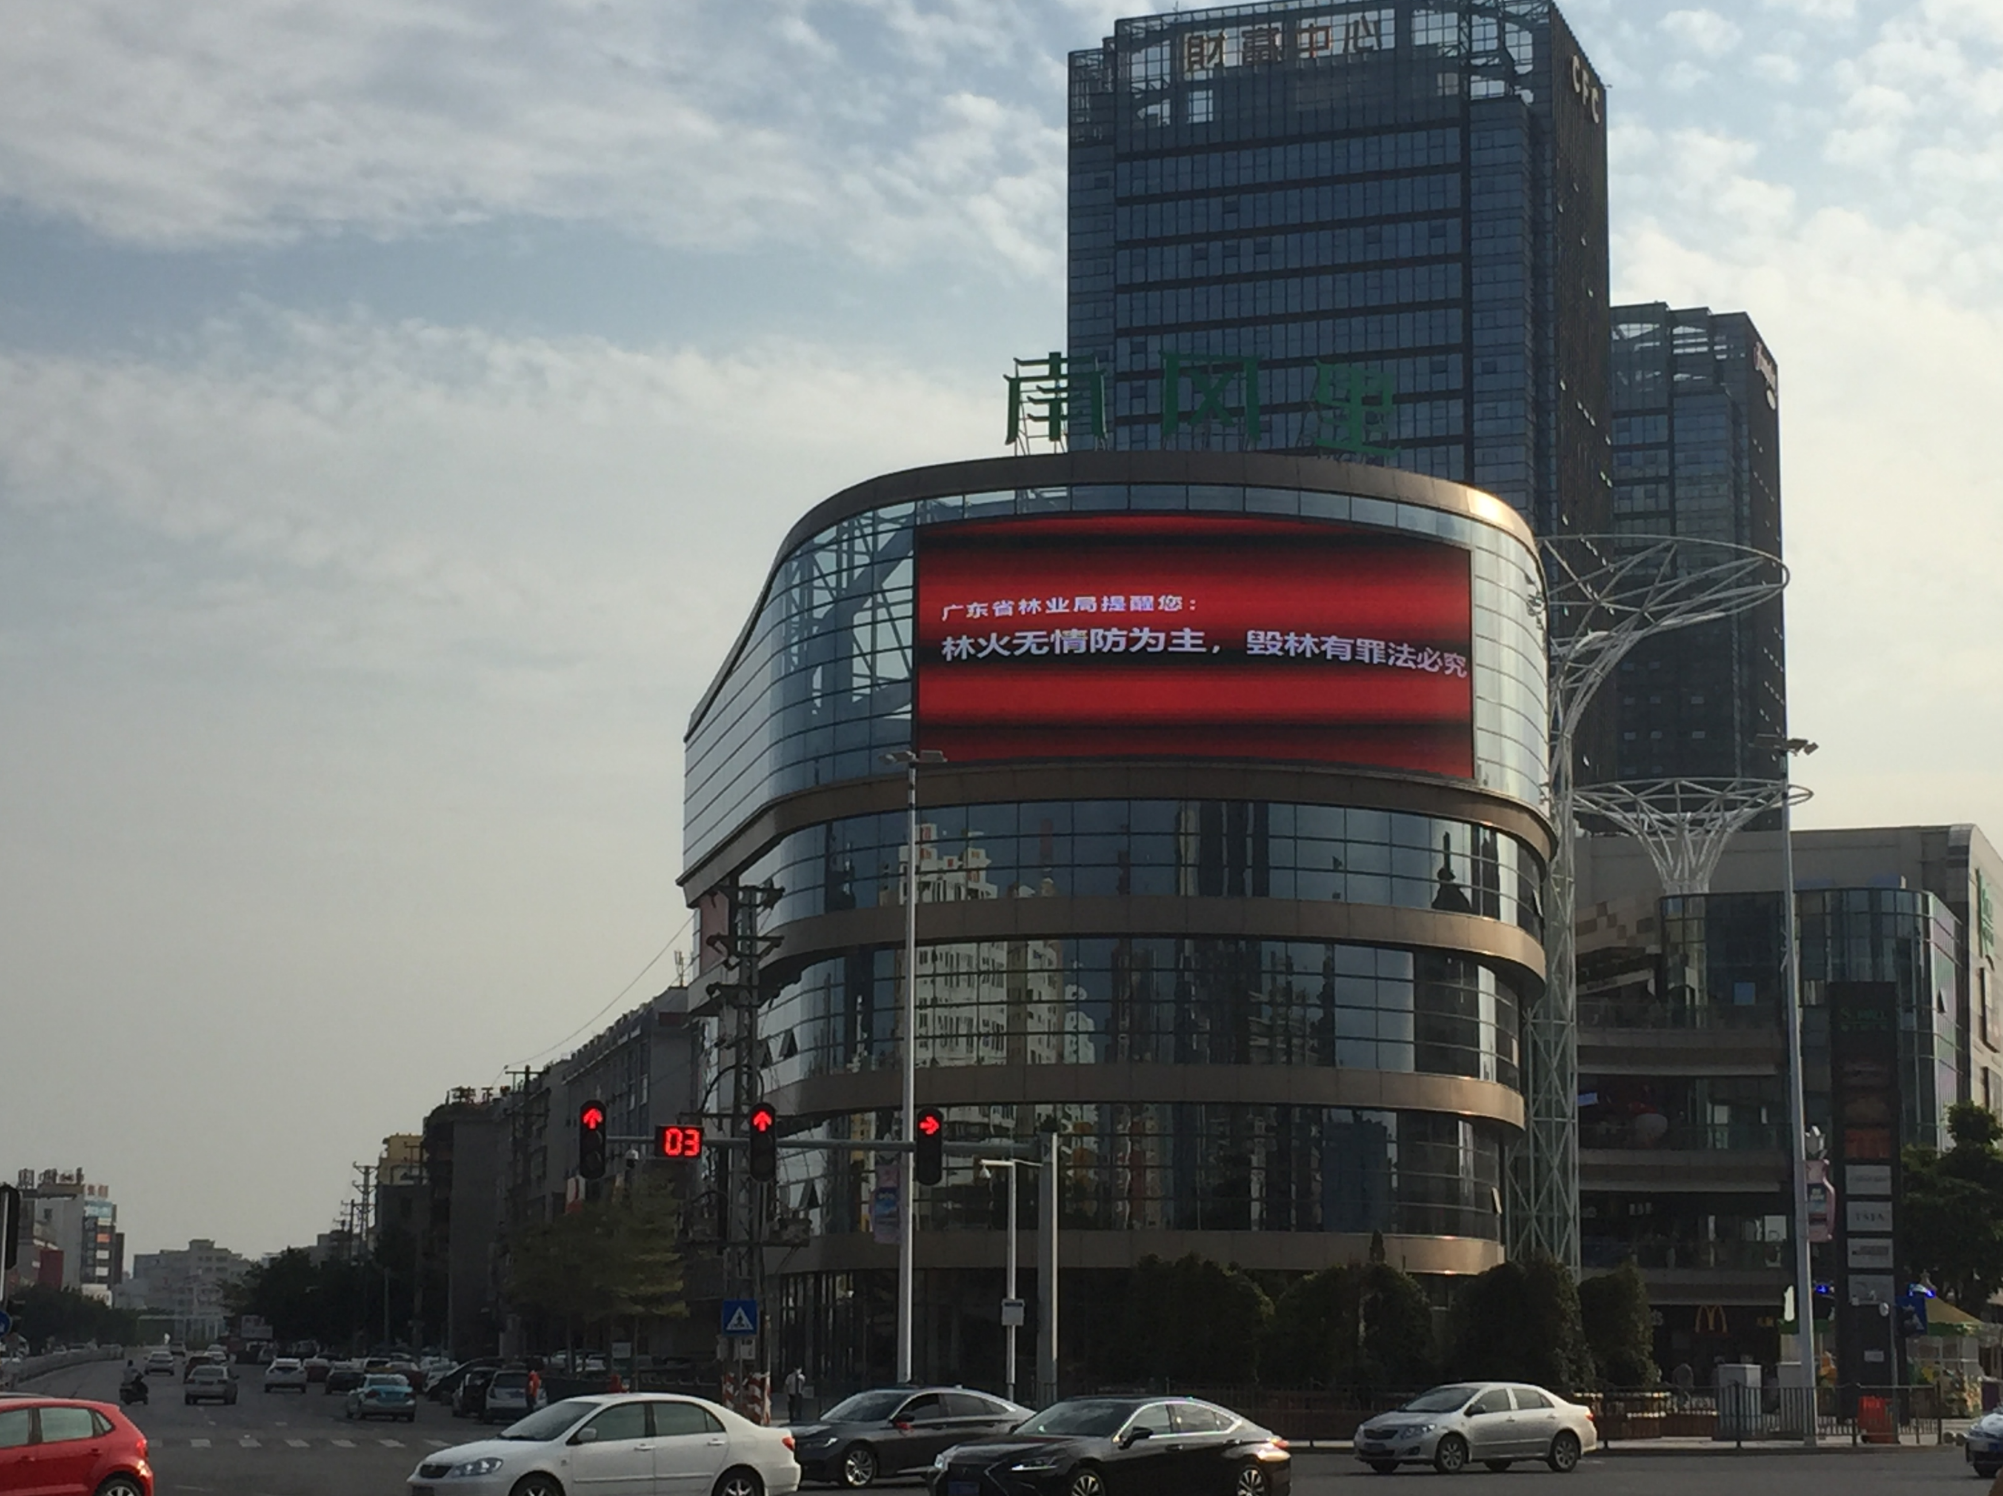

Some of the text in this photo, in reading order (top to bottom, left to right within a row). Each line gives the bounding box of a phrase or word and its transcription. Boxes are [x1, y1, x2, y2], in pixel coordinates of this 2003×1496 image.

[1186, 15, 1381, 72] 財富中心
[1572, 54, 1600, 124] CFC
[665, 1127, 700, 1156] 03
